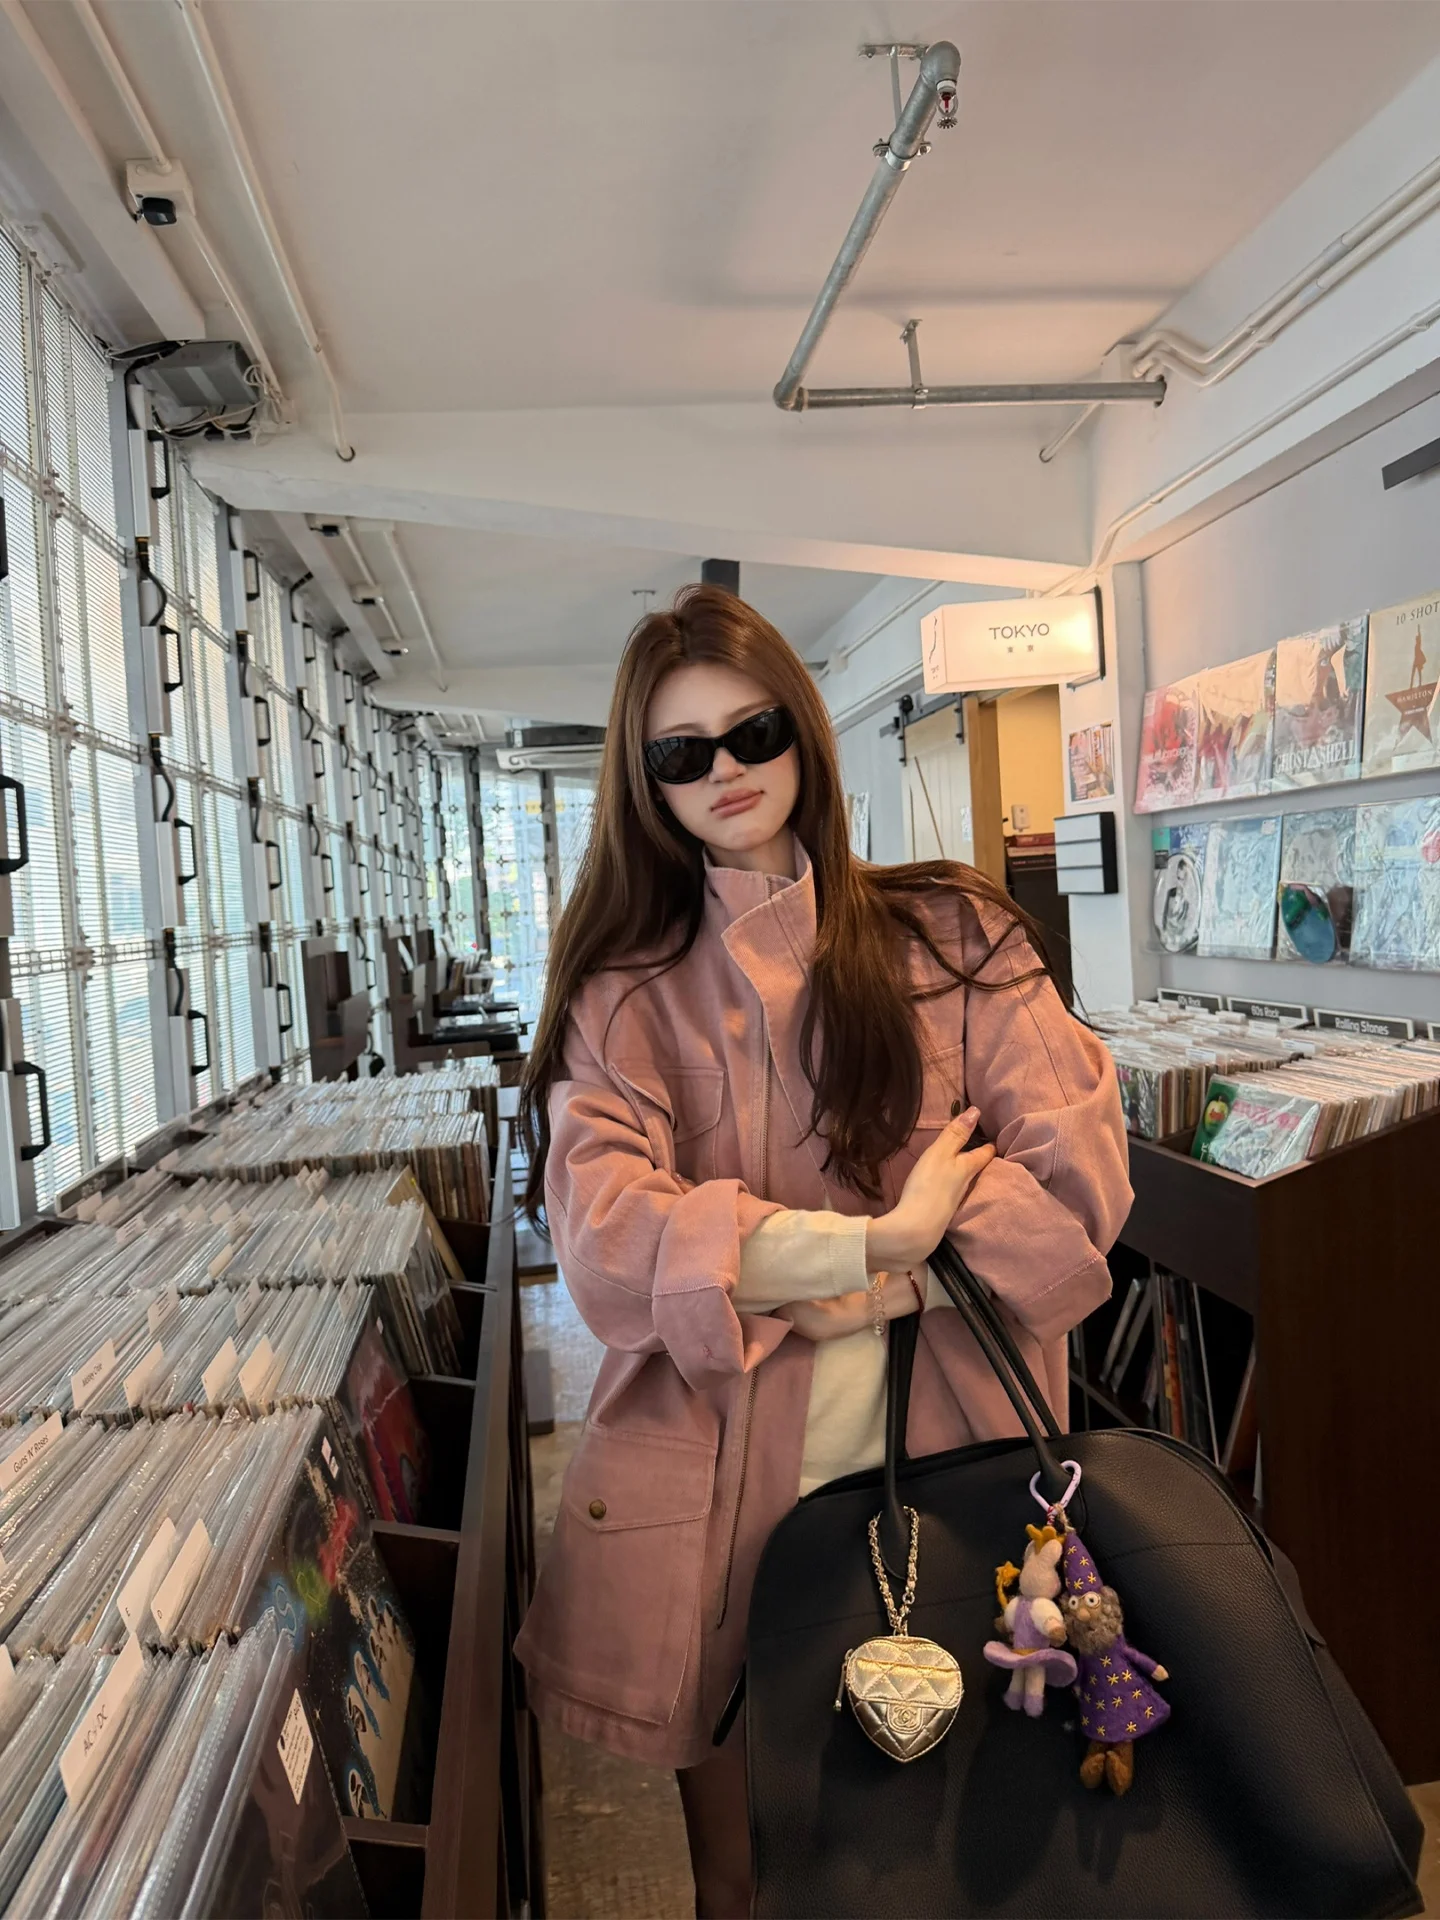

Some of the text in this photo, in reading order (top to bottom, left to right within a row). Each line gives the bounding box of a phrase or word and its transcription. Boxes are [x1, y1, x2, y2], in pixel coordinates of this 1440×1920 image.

[1396, 612, 1406, 626] 10
[988, 622, 1050, 640] TOKYO
[1250, 1005, 1280, 1018] 60s Rock
[1334, 1016, 1390, 1036] Rolling Stones
[13, 1455, 29, 1473] Guns
